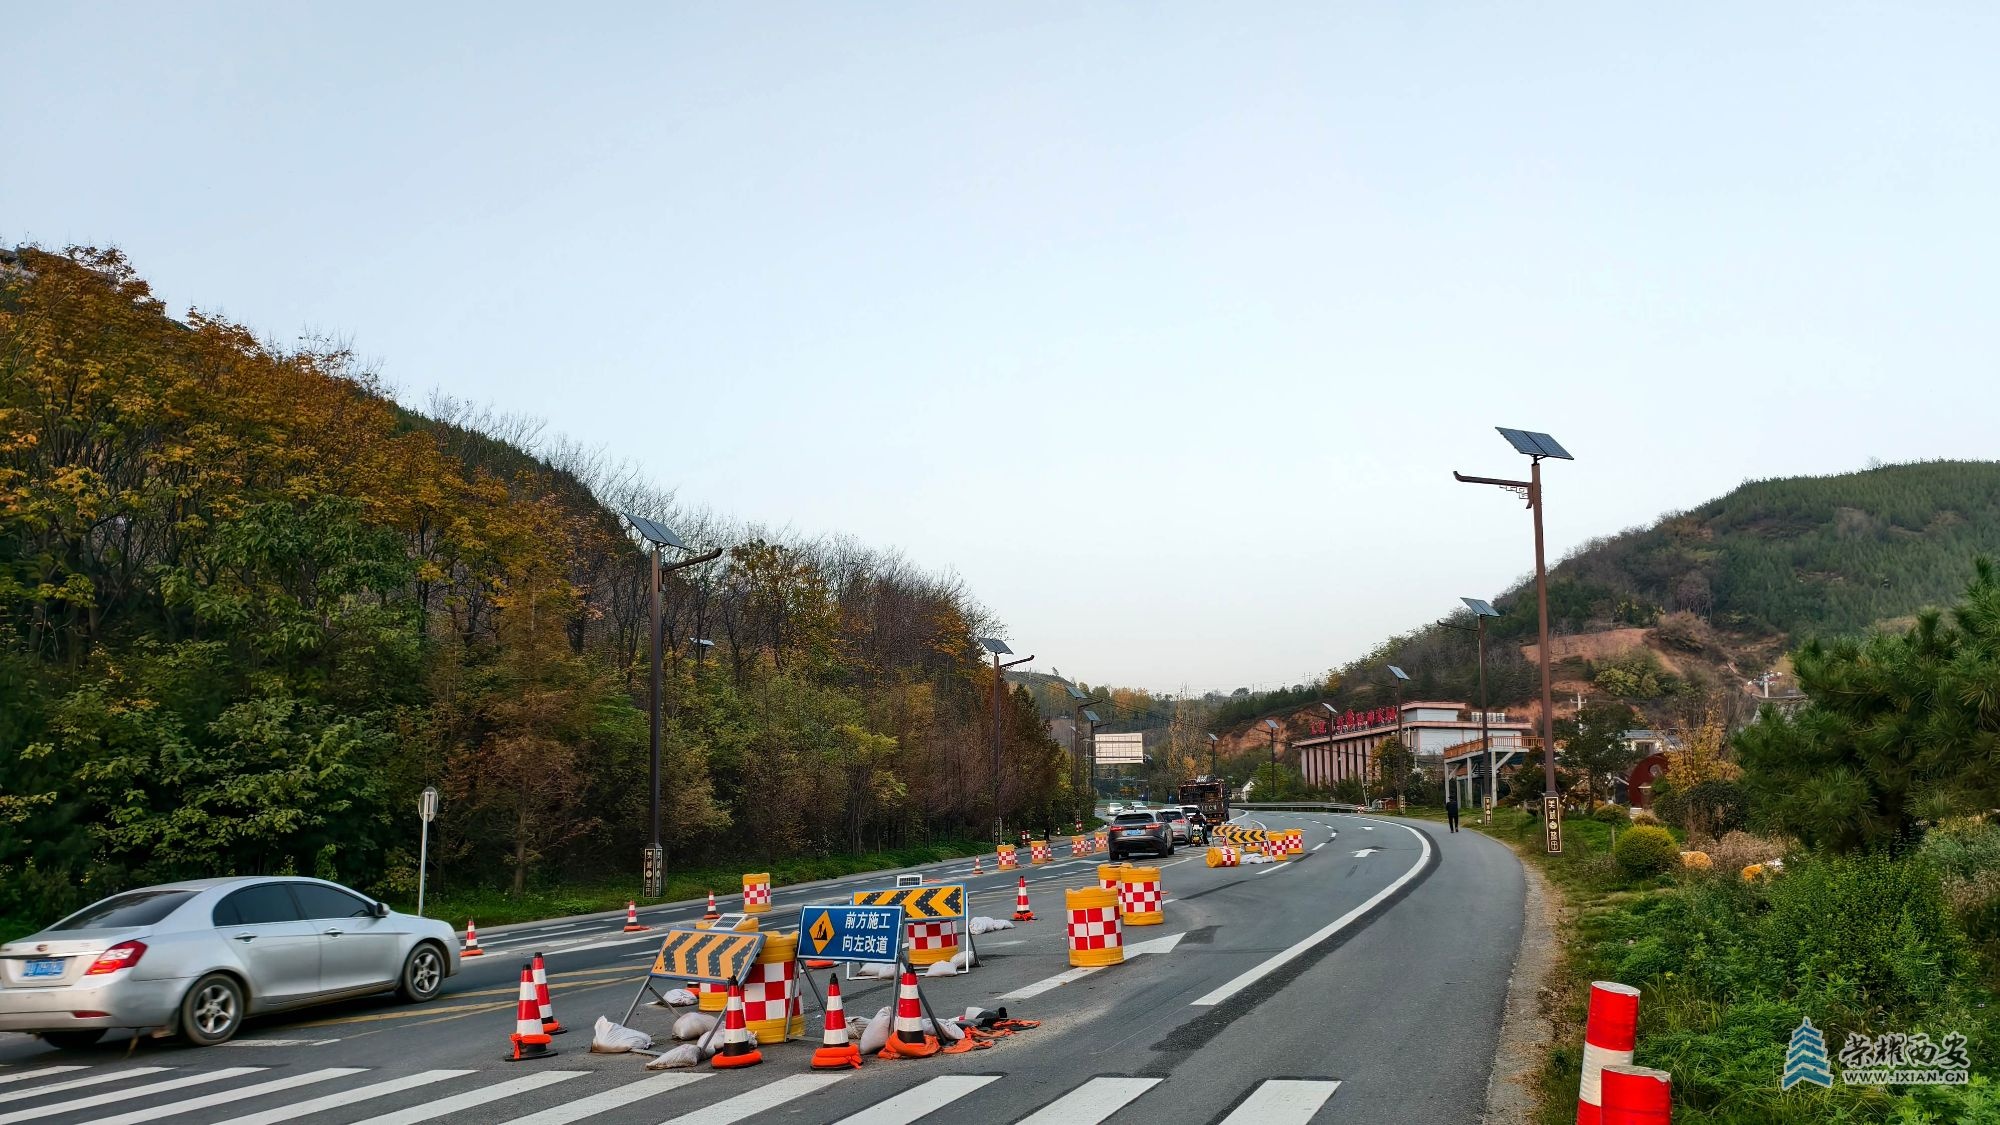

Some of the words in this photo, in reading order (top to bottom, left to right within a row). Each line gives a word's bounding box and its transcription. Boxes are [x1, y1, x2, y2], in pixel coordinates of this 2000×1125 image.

[845, 912, 891, 930] 前方施工
[842, 934, 888, 954] 向左改道
